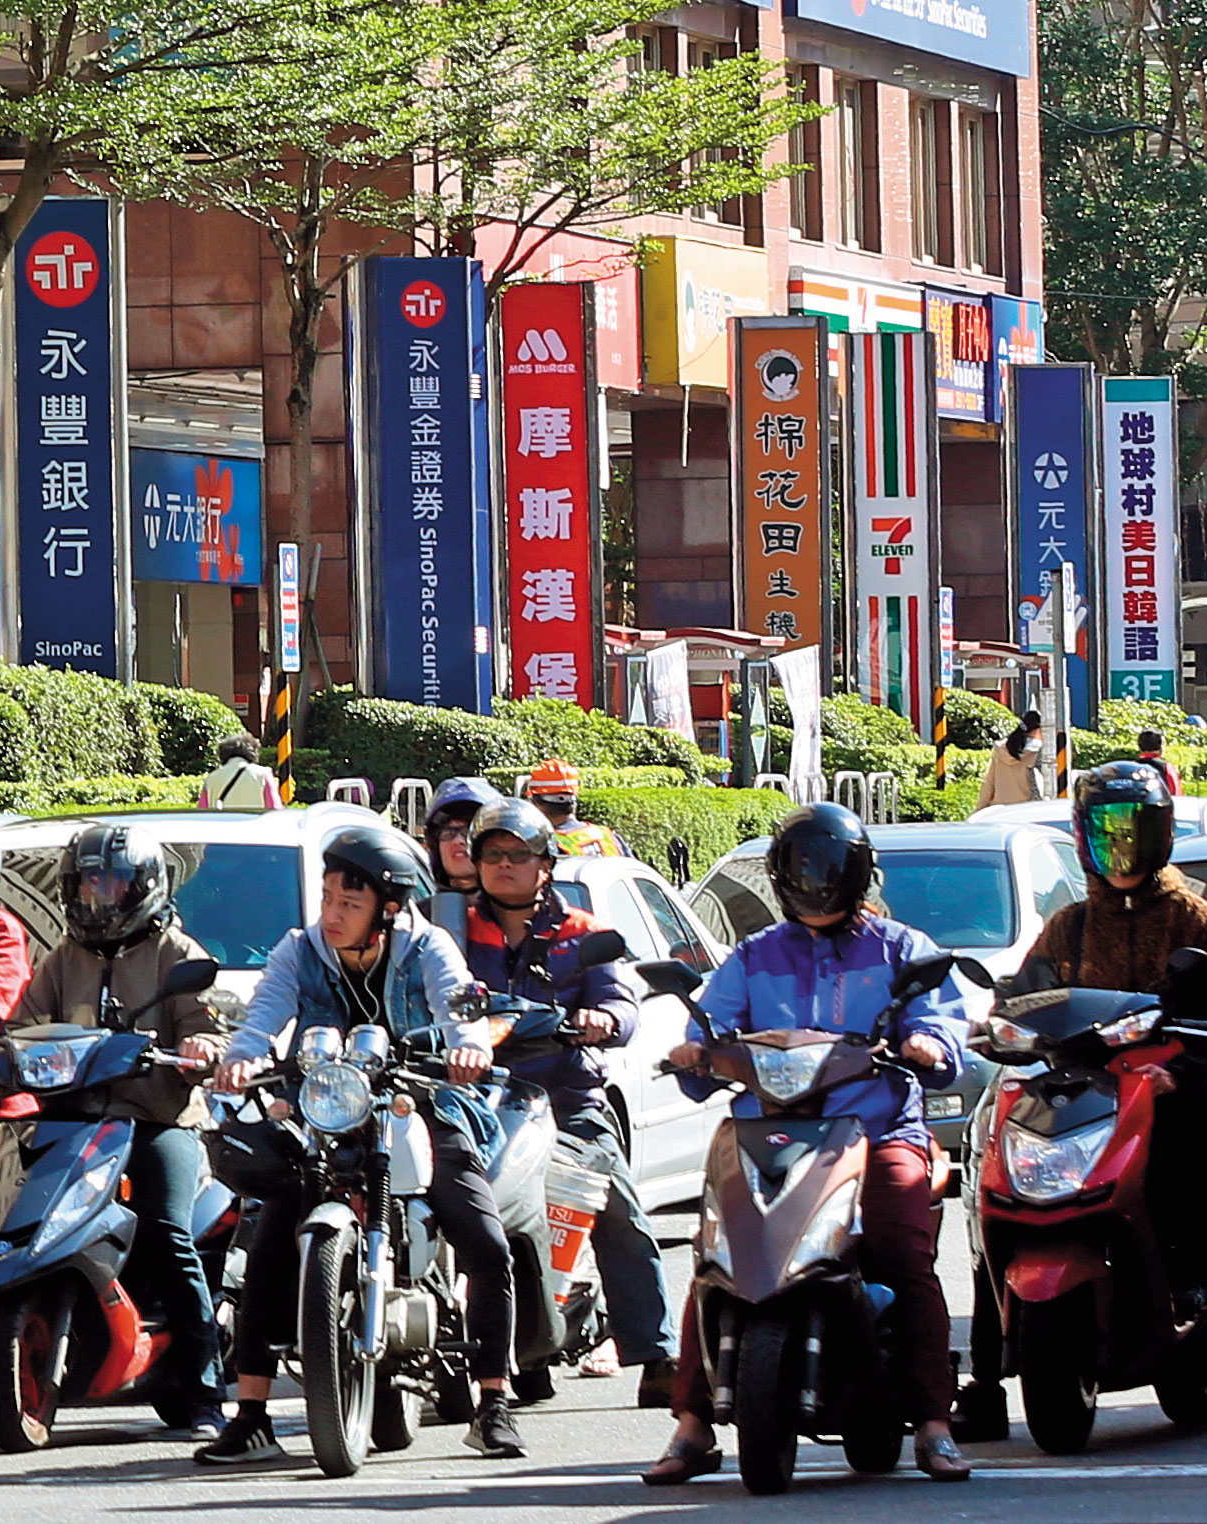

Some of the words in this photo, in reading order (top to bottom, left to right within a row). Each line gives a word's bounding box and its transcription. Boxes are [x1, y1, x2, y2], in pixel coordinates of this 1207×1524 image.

[39, 328, 92, 579] 永豐銀行
[408, 338, 444, 521] 永豐金證券
[508, 364, 533, 375] MOS
[534, 363, 576, 375] BURGER
[419, 527, 439, 612] SinoPac
[518, 406, 579, 702] 摩斯漢堡
[754, 411, 806, 642] 棉花田生機
[1119, 411, 1160, 662] 地球村美日韓語
[35, 638, 103, 658] SinoPac
[1122, 674, 1162, 701] 3F
